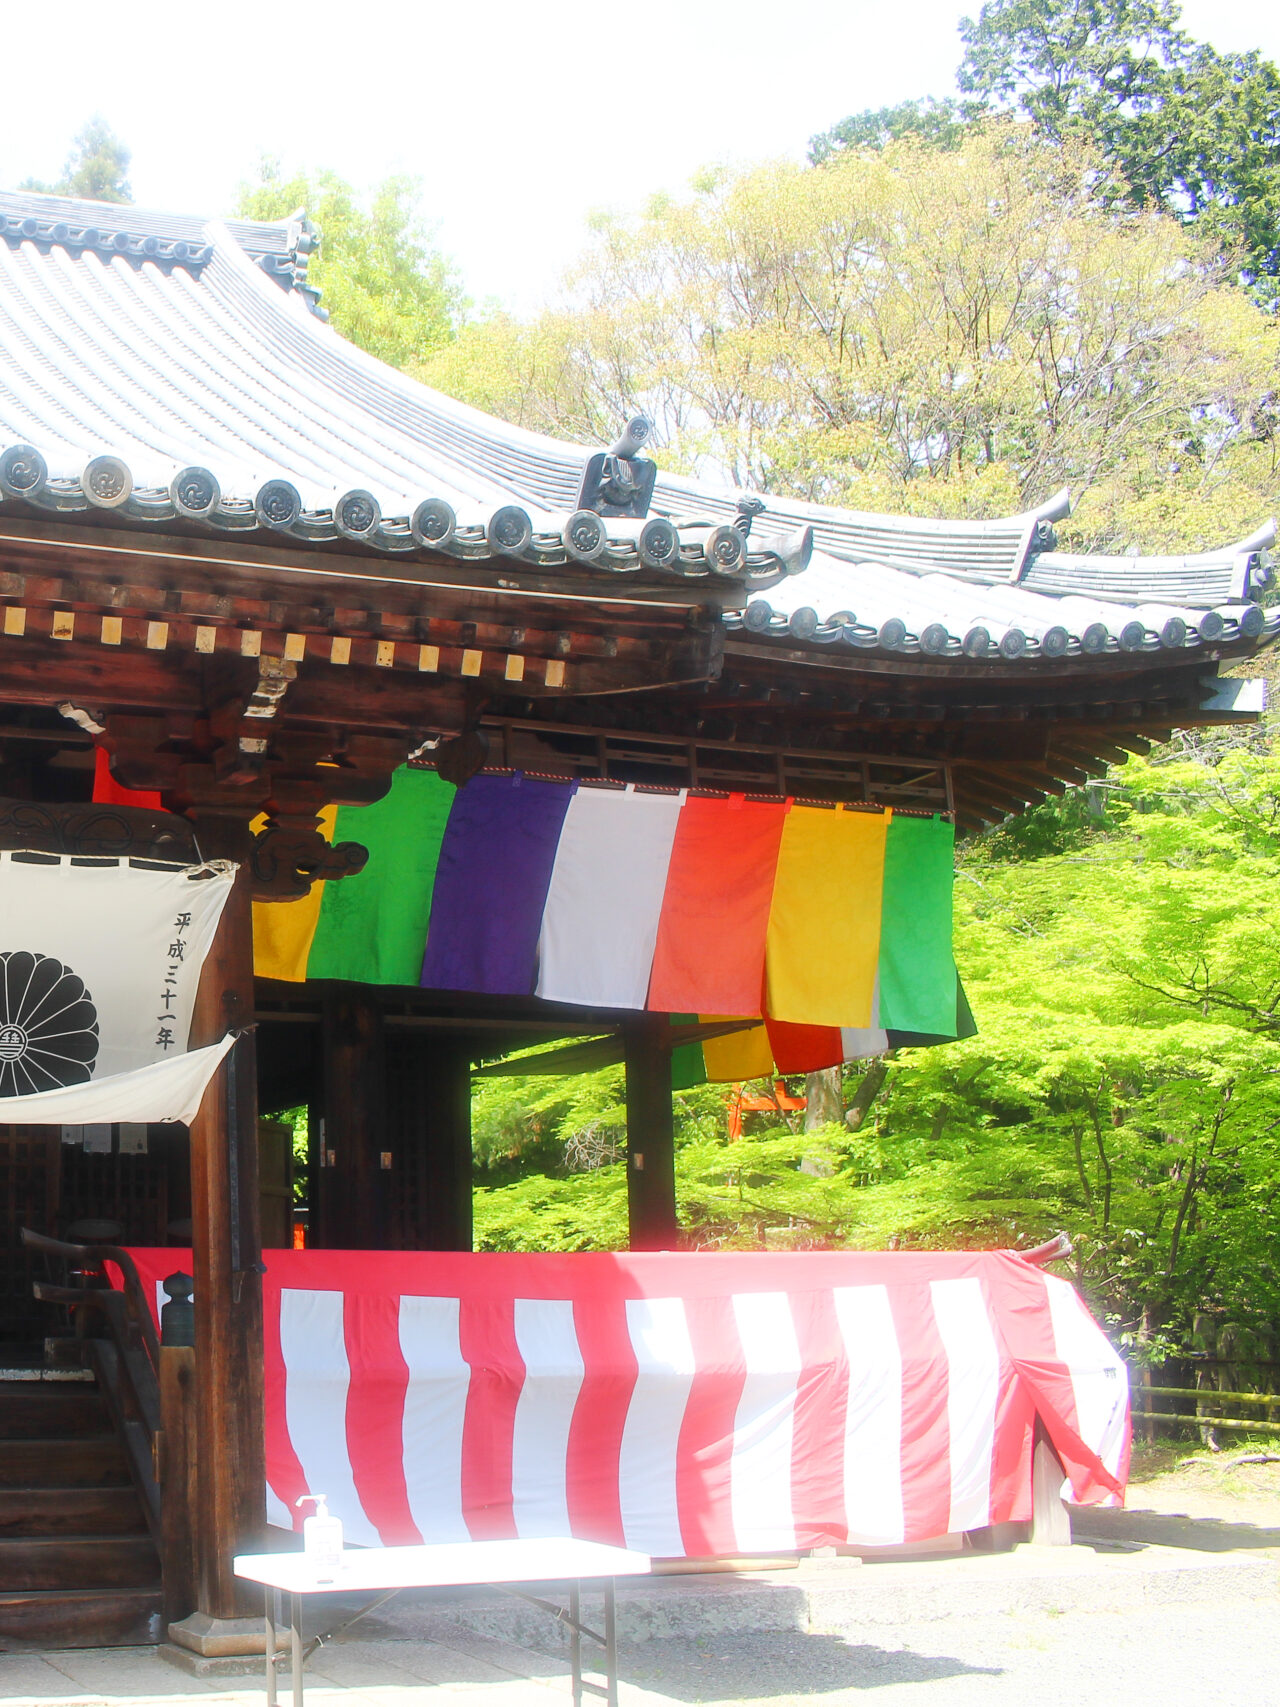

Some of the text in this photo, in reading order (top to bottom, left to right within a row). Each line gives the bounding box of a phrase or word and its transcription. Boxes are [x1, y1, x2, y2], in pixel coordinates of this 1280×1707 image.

[153, 910, 193, 1052] 平成三十一年
